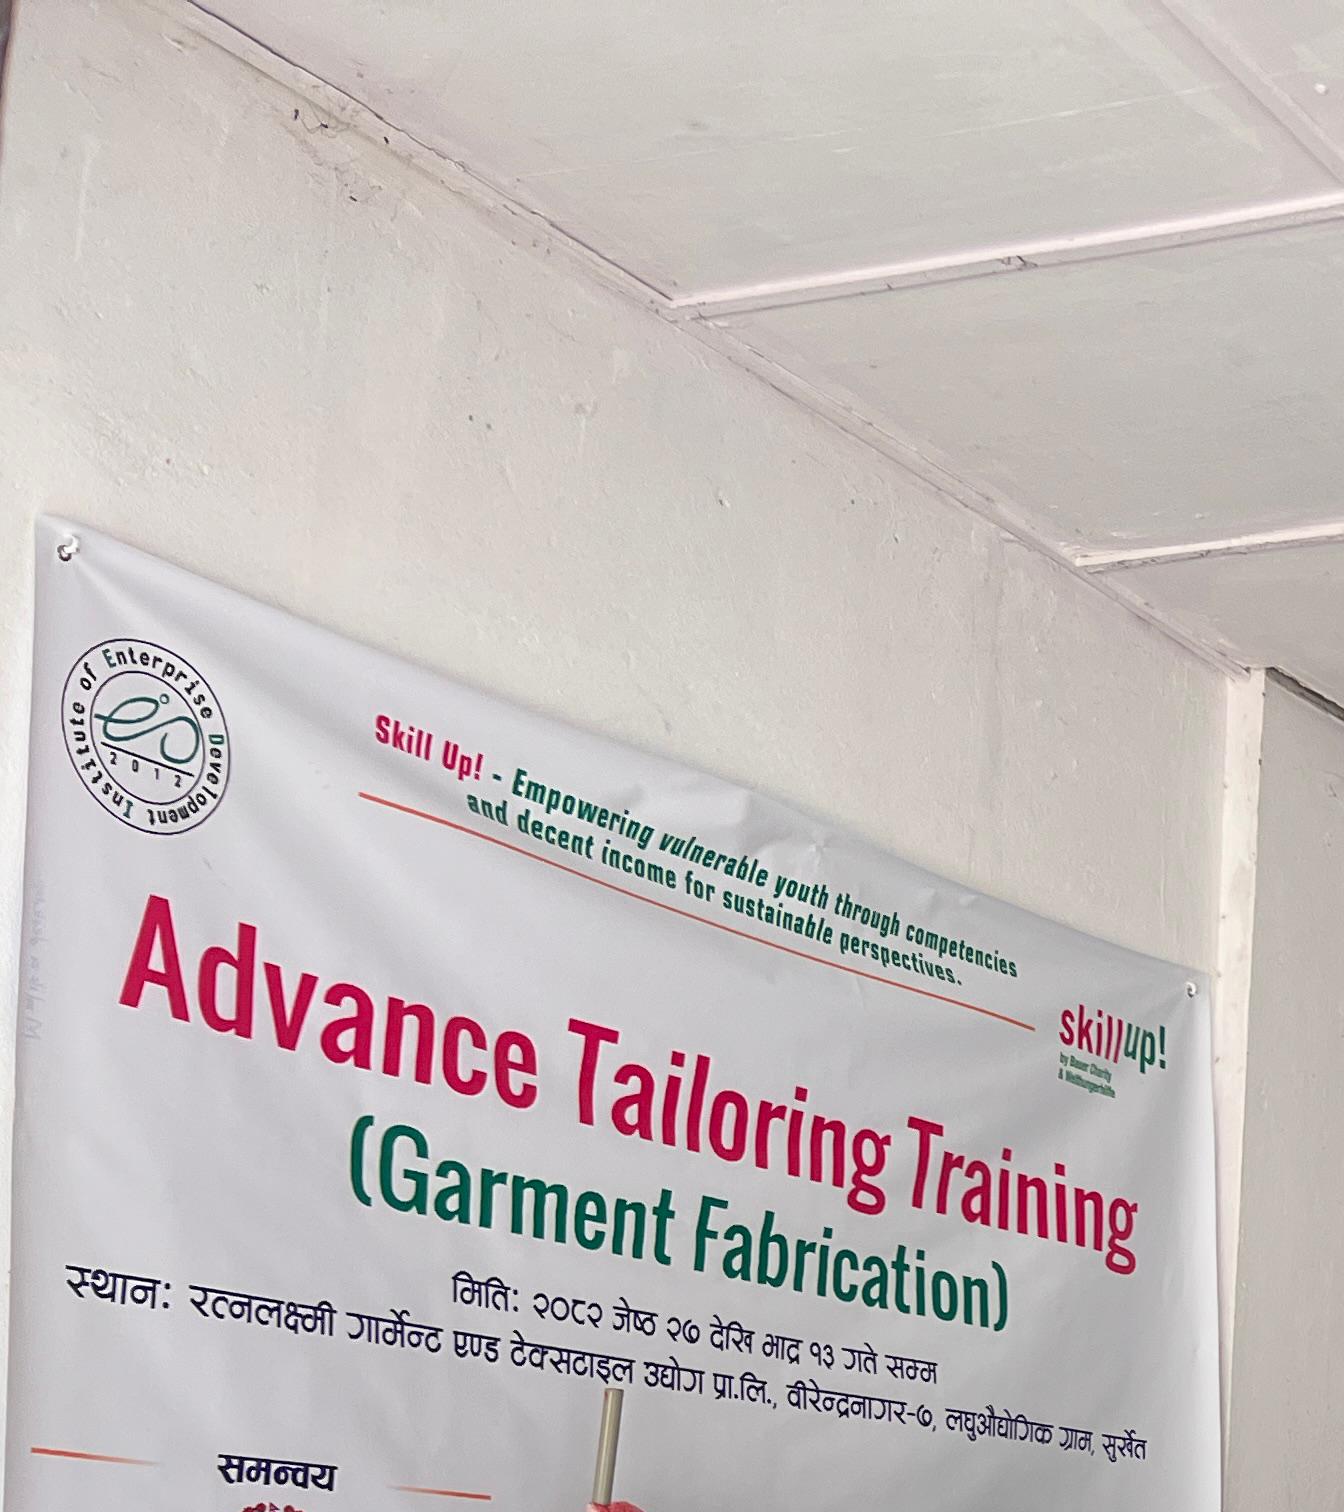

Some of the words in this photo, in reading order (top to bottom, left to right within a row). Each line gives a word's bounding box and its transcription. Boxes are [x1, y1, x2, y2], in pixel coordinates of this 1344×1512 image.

[79, 661, 97, 691] of
[101, 646, 214, 720] Enterprise
[69, 701, 134, 819] Institute
[147, 733, 225, 826] Development
[374, 713, 434, 761] Skill
[441, 739, 484, 781] Up!
[510, 767, 655, 851] Empowering
[658, 831, 769, 888] vulnerable
[773, 873, 829, 910] youth
[834, 892, 901, 937] through
[906, 923, 1018, 979] competencies
[466, 793, 508, 827] and
[516, 808, 594, 860] decent
[601, 838, 677, 890] income
[684, 870, 715, 902] for
[722, 888, 834, 946] sustainable
[839, 931, 963, 987] perspectives.
[117, 893, 539, 1110] Advance
[567, 1017, 892, 1217] Tailoring
[906, 1115, 1139, 1276] Training
[349, 1114, 676, 1267] (Garment
[693, 1194, 1009, 1333] Fabrication)
[188, 1284, 338, 1337] रत्नलक्ष्मी
[345, 1307, 444, 1354] गार्मेन्ट
[452, 1330, 501, 1363] एण्ड
[509, 1329, 636, 1385] टेक्सटाइल
[643, 1355, 705, 1395] उद्योग
[1101, 1428, 1148, 1463] सुर्खेत
[533, 1292, 603, 1328] २०८२
[612, 1296, 658, 1337] जेष्ठ
[666, 1316, 701, 1344] २७
[709, 1314, 755, 1354] देखि
[761, 1333, 804, 1365] भाद्र
[809, 1342, 835, 1370] १३
[841, 1342, 879, 1375] गते
[884, 1354, 939, 1385] सम्म
[216, 1453, 339, 1492] समन्वय
